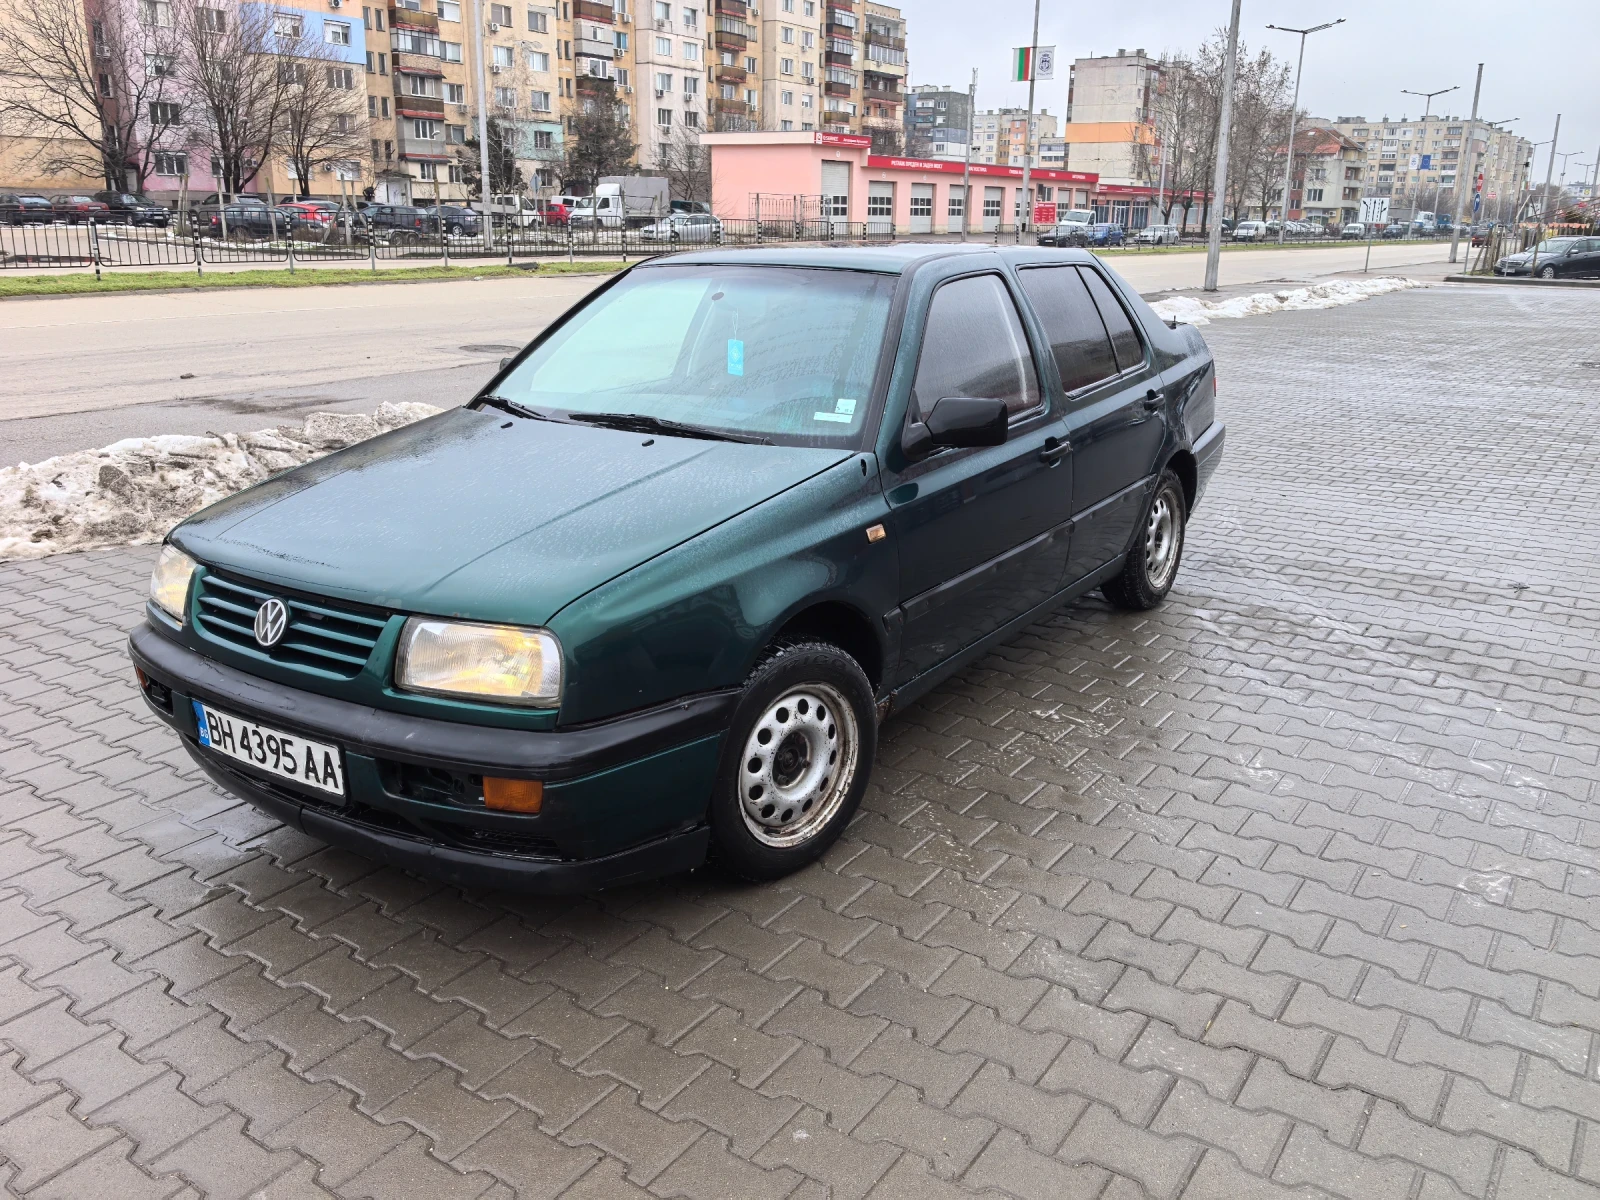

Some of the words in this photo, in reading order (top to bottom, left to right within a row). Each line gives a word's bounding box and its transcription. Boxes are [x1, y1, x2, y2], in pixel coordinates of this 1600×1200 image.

[200, 726, 209, 738] BG
[205, 710, 237, 754] BH
[239, 725, 298, 775] 4395
[304, 745, 340, 790] AA
